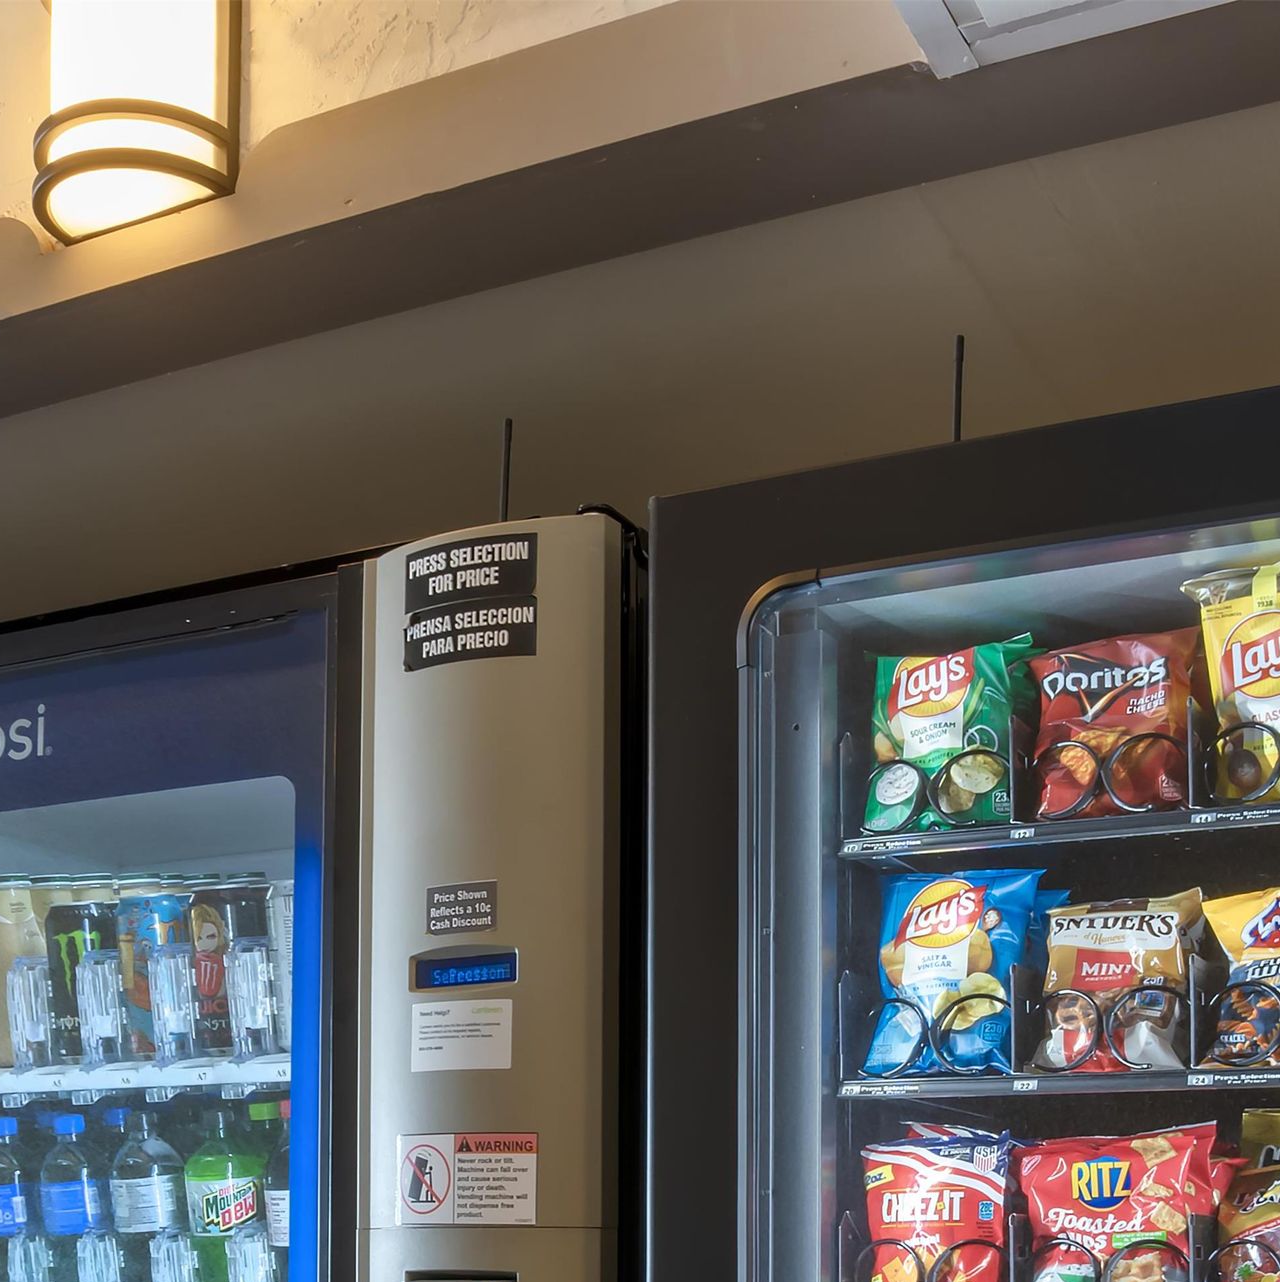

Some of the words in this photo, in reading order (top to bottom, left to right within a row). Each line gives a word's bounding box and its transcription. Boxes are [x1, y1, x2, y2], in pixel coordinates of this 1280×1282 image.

[409, 552, 446, 579] PRESS
[450, 542, 528, 568] SELECTION
[428, 573, 453, 595] FOR
[457, 567, 499, 589] PRICE
[407, 615, 451, 642] PRENSA
[455, 607, 534, 629] SELECCION
[423, 636, 453, 658] PARA
[458, 630, 508, 650] PRECIO
[898, 654, 966, 709] Lay's
[1042, 658, 1166, 700] Doritos
[1126, 698, 1165, 715] CHEESE
[1130, 690, 1165, 706] NACHO
[910, 726, 928, 737] SOUR
[930, 722, 956, 733] CREAM
[434, 892, 455, 902] Price
[458, 889, 487, 901] Shown
[430, 906, 464, 918] Reflects
[430, 918, 450, 930] Cash
[453, 916, 491, 928] Discount
[906, 890, 976, 939] Lay's
[1054, 914, 1176, 938] SNYDER'S
[196, 1072, 207, 1081] A7
[276, 1068, 287, 1078] A8
[474, 1141, 533, 1152] WARNING
[976, 1146, 996, 1157] USA
[1072, 1161, 1132, 1201] RITZ
[882, 1190, 965, 1223] CHEEZ-IT
[1048, 1207, 1146, 1233] Toasted
